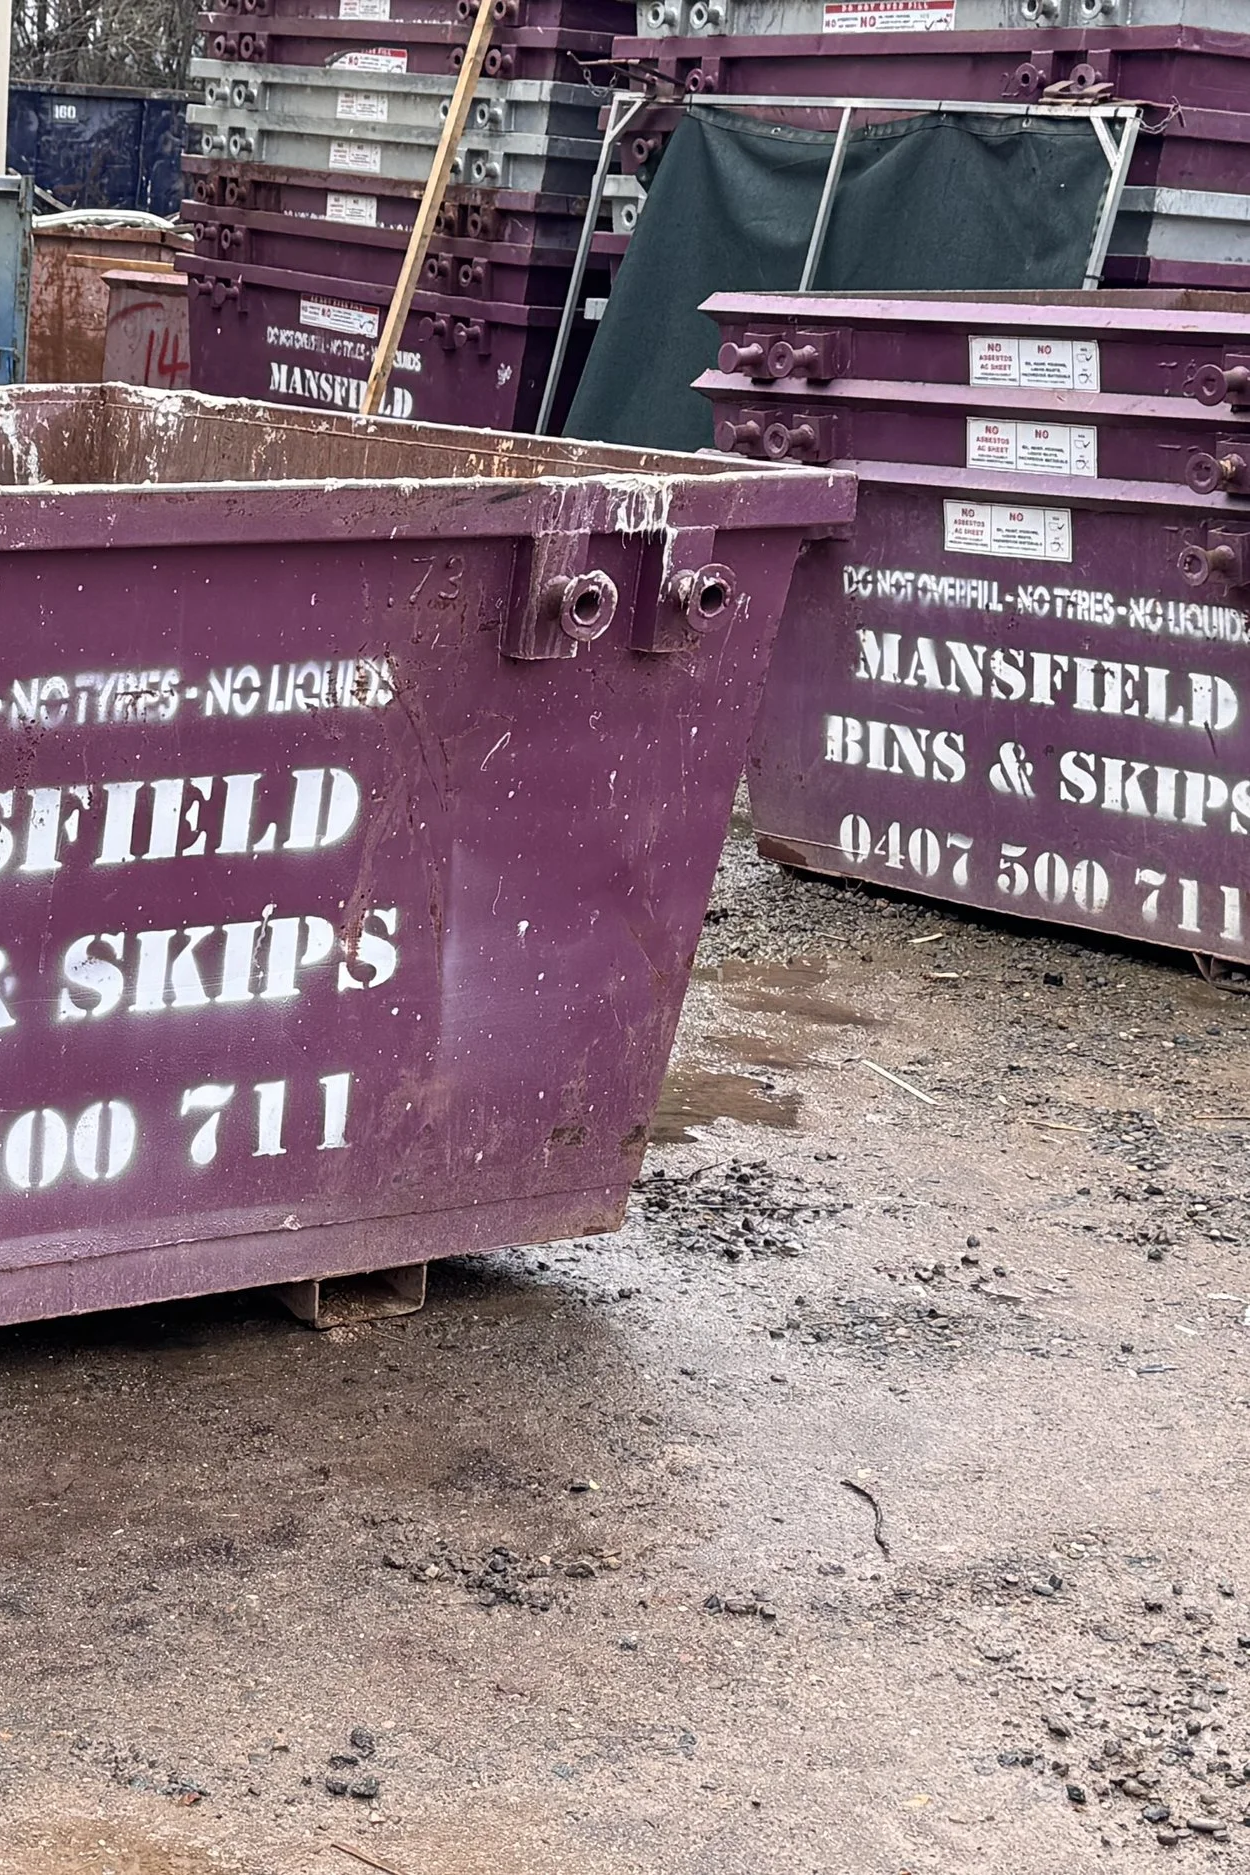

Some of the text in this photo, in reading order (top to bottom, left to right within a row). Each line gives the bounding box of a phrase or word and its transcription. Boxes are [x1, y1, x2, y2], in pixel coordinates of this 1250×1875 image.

[860, 16, 876, 28] NO
[144, 327, 190, 389] 14
[987, 343, 1002, 352] NO
[1037, 345, 1052, 355] NO
[985, 425, 999, 435] NO
[1035, 429, 1049, 439] NO
[961, 508, 975, 518] NO
[1009, 512, 1024, 522] NO
[842, 564, 873, 597] DO
[876, 568, 913, 599] NOT
[916, 572, 1004, 614] OVERFILL
[1017, 584, 1049, 617] NO
[1053, 587, 1115, 626] TYRES
[1129, 597, 1164, 633] NO
[11, 676, 70, 731] NO
[205, 664, 262, 717] NO
[854, 629, 1239, 732] MANSFIELD
[824, 714, 966, 784] BINS
[988, 741, 1037, 799] &
[839, 812, 1243, 942] 0407 500 711
[60, 907, 402, 1023] SKIPS
[180, 1072, 354, 1168] 711
